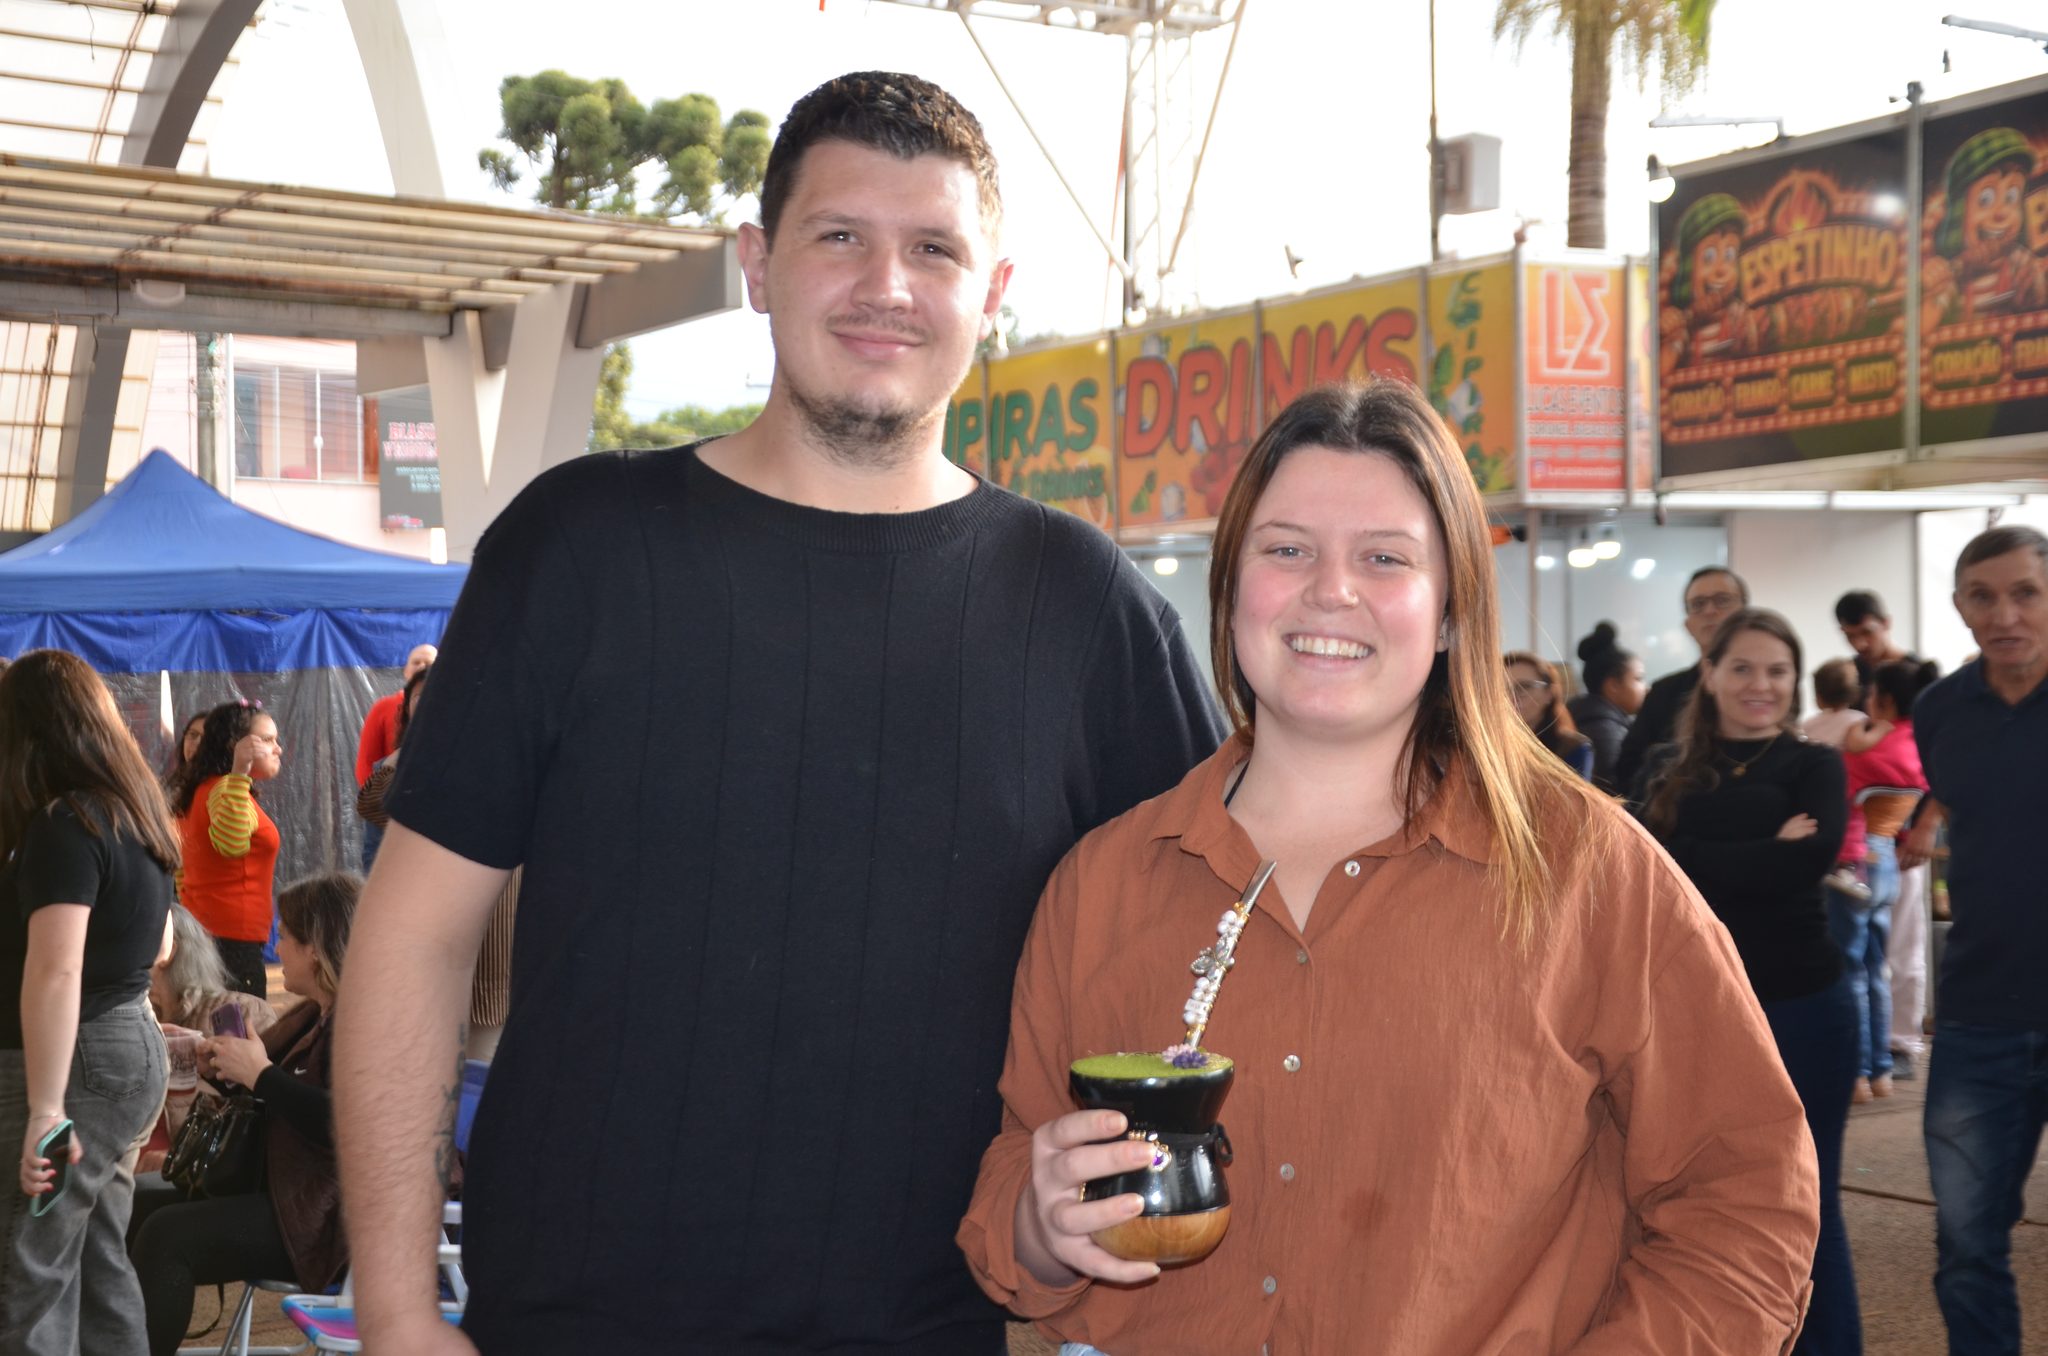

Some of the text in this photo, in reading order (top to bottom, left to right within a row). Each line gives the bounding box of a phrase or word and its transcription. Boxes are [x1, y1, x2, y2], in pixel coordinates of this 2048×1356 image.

[1740, 224, 1898, 303] ESPETINHO
[943, 378, 1099, 465] IPIRAS
[1124, 307, 1416, 458] DRINKS
